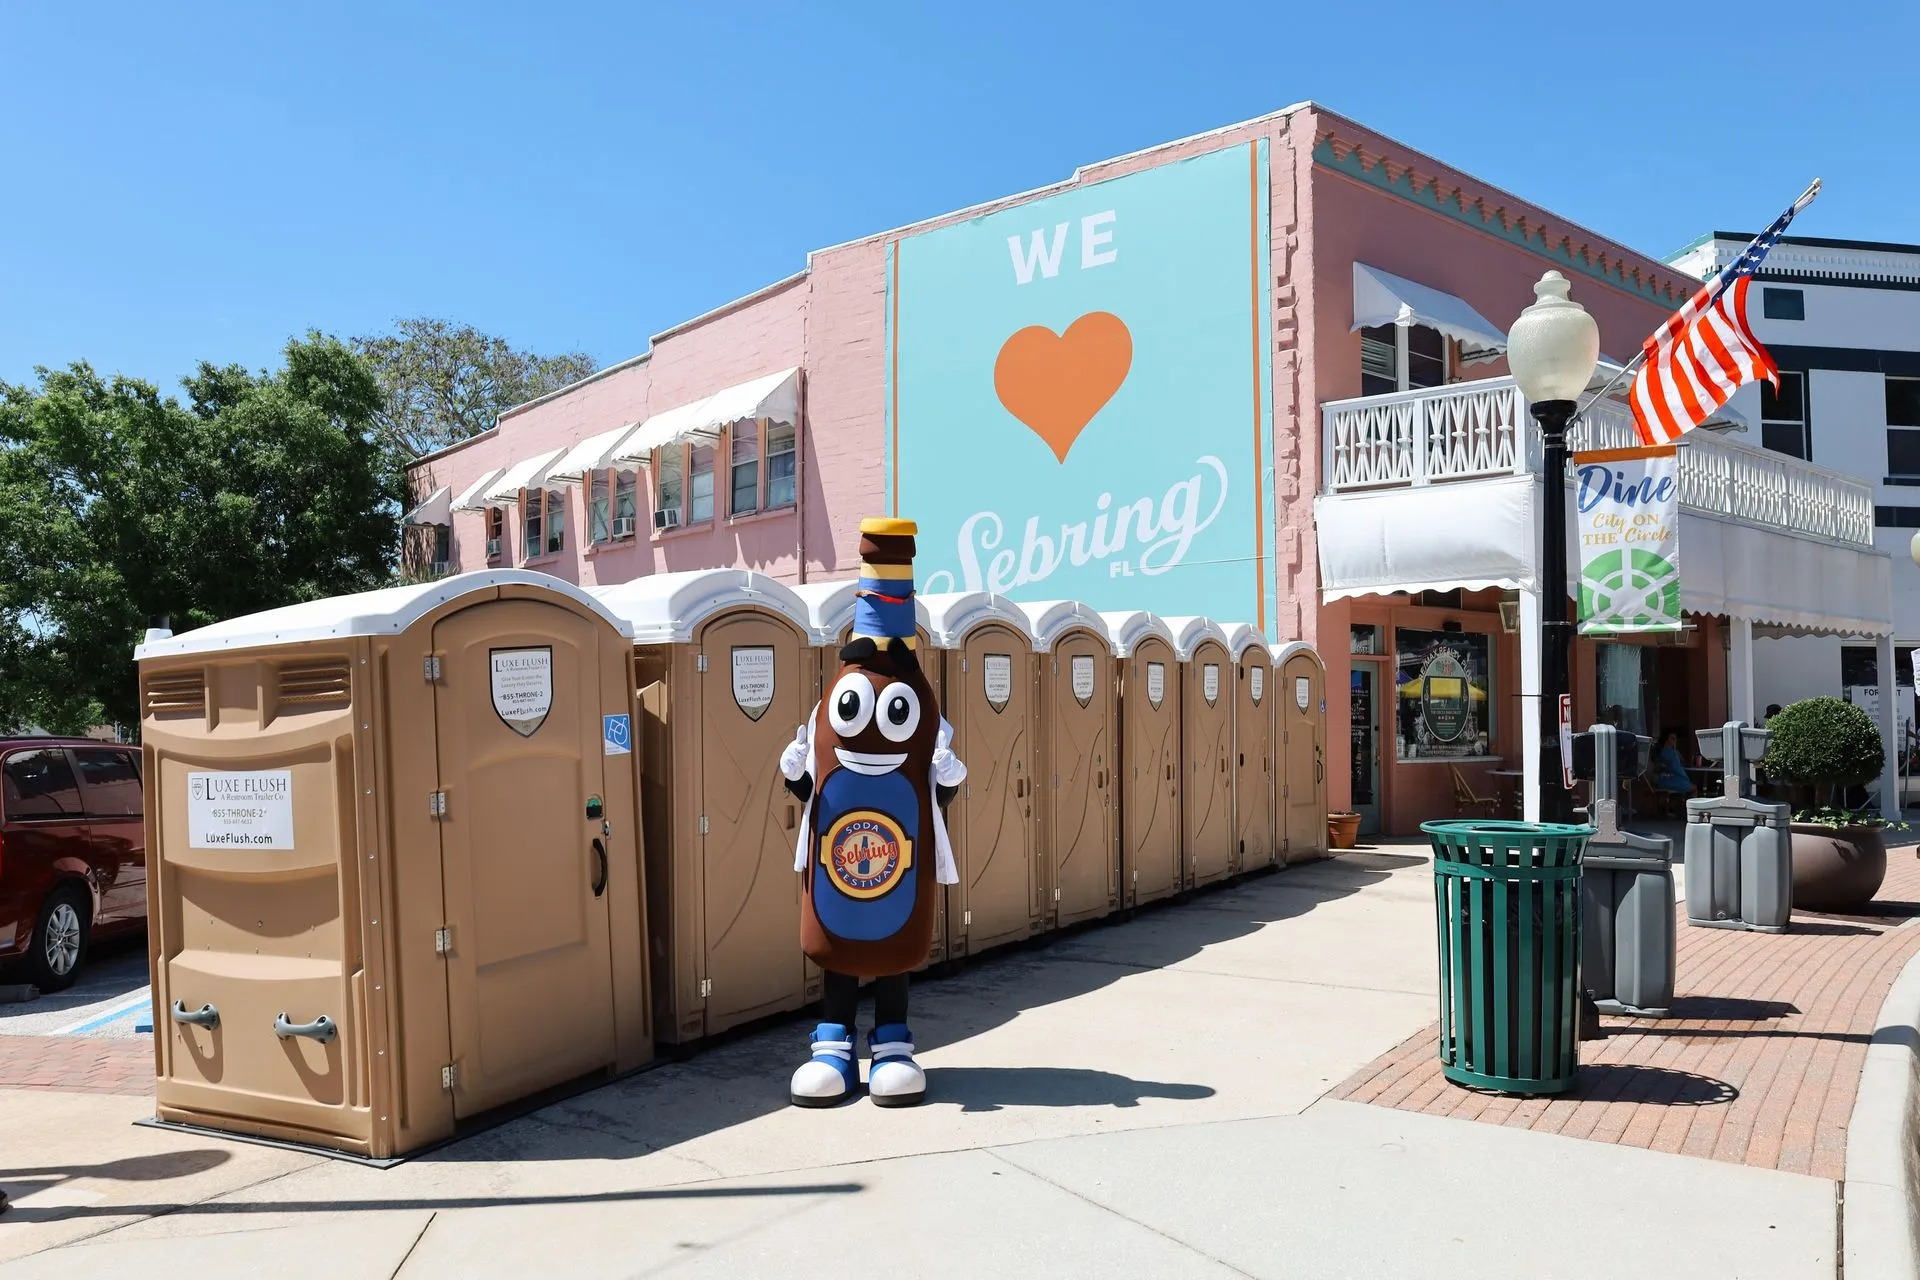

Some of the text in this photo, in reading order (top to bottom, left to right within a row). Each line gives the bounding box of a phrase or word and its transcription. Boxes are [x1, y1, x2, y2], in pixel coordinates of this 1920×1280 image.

[1007, 209, 1118, 285] WE
[1577, 465, 1676, 513] Dine
[923, 455, 1228, 595] Sebring
[1593, 512, 1659, 533] City ON
[1583, 527, 1672, 545] THE Circle
[1110, 561, 1134, 578] FL
[495, 658, 548, 672] LUXE FLUSH
[501, 707, 547, 716] LuxeFlush.com
[205, 778, 286, 800] LUXE FLUSH
[205, 833, 273, 844] LuxeFlush.com
[845, 822, 880, 834] SODA
[834, 841, 898, 867] Sebring
[836, 861, 896, 888] FESTIVAL
